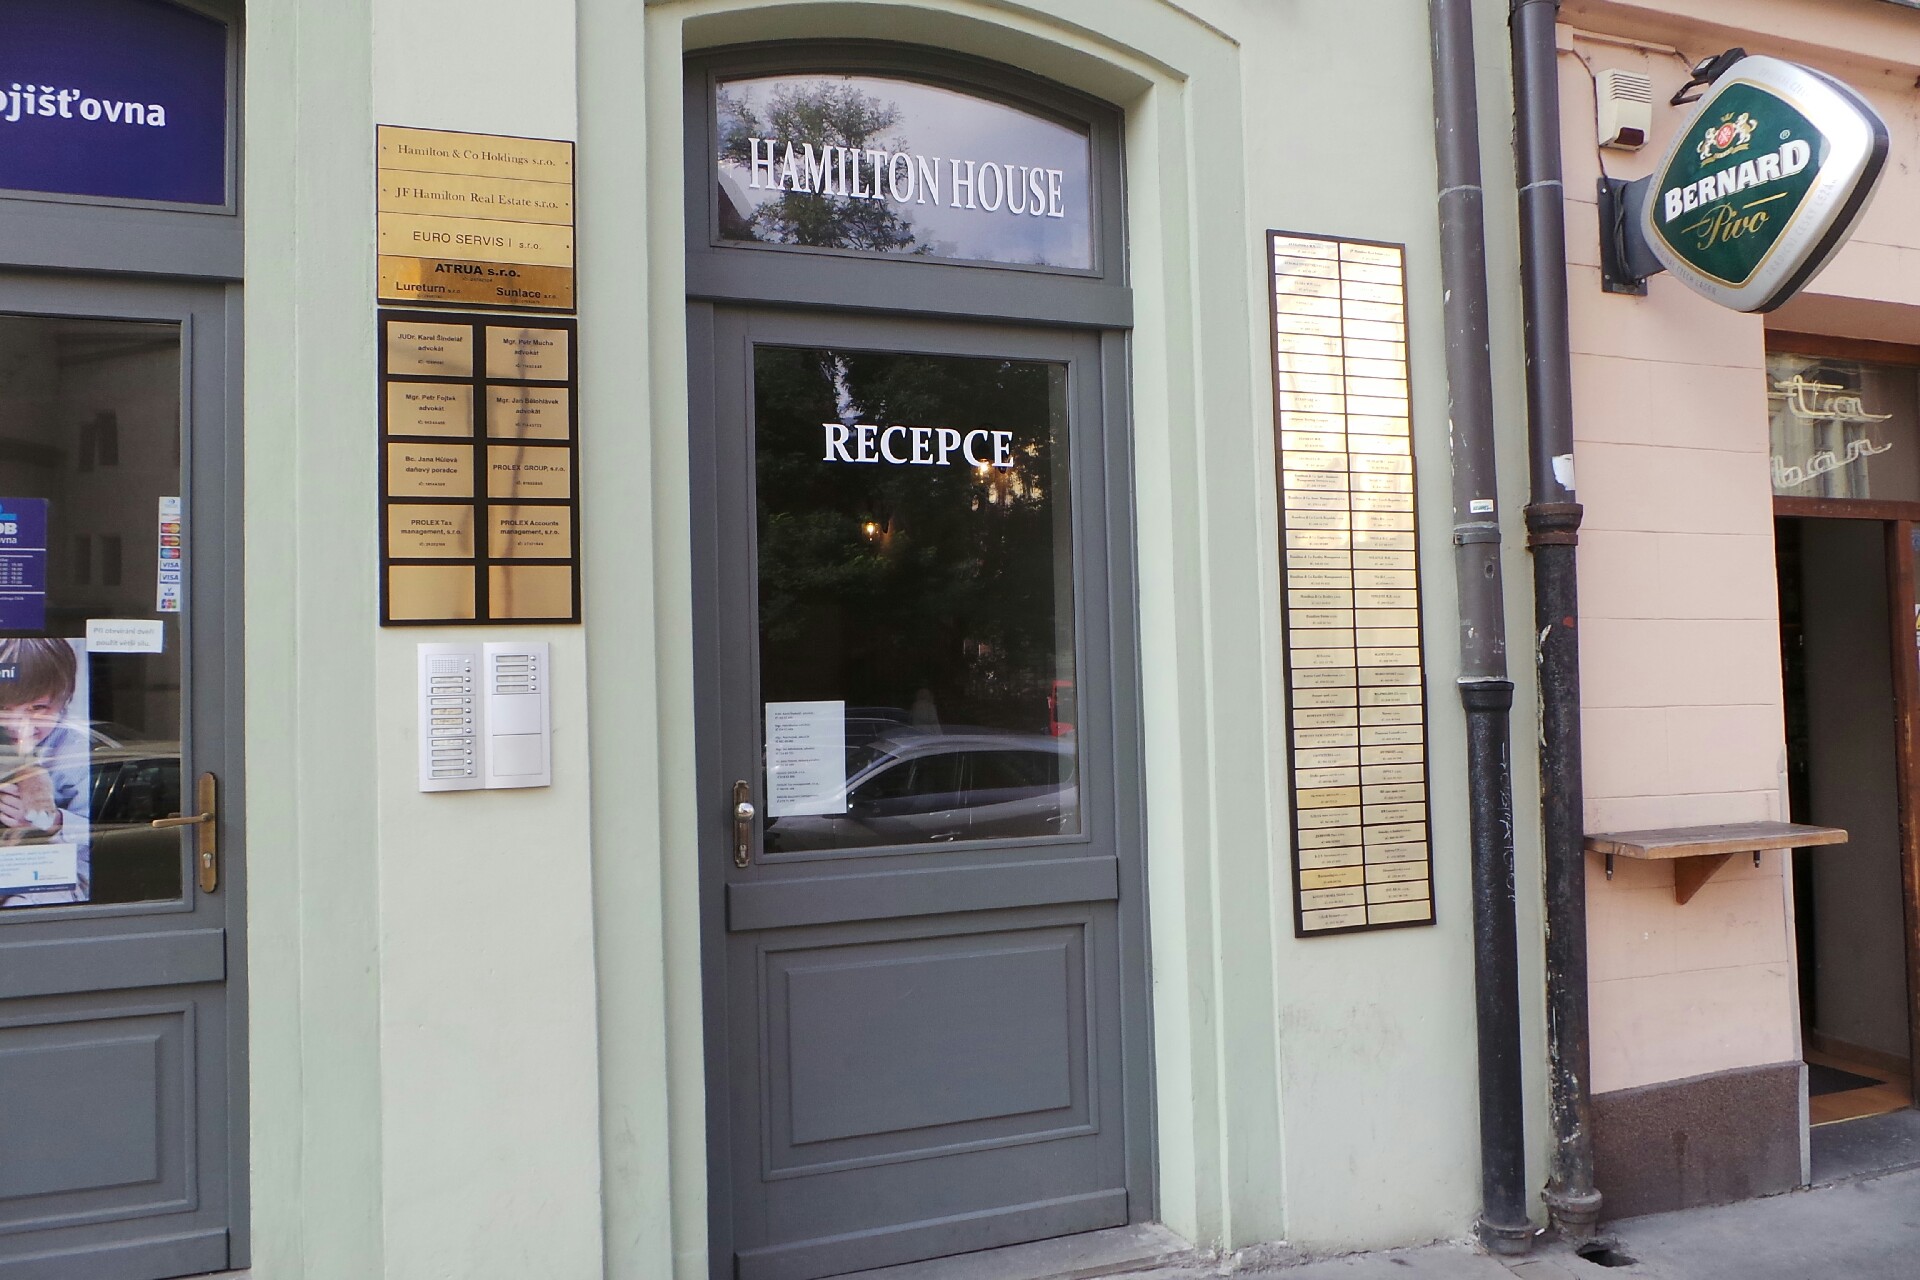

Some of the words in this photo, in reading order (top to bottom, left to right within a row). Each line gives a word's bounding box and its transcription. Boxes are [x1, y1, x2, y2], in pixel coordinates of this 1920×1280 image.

[398, 144, 449, 158] Hamilton
[452, 149, 461, 158] &
[463, 150, 479, 160] Co
[481, 151, 529, 165] Holdings
[532, 158, 556, 167] s.r.o.
[748, 137, 941, 206] HAMILTON
[950, 158, 1065, 218] HOUSE
[1664, 139, 1811, 224] BERNARD
[395, 187, 410, 198] JF
[413, 188, 465, 202] Hamilton
[470, 192, 494, 204] Real
[498, 195, 532, 207] Estate
[534, 200, 559, 210] s.r.o.
[1696, 201, 1770, 251] Pivo
[413, 231, 451, 243] EURO
[455, 234, 504, 247] SERVIS
[518, 242, 542, 250] s.r.o.
[435, 263, 483, 276] ATRUA
[487, 267, 521, 278] s.r.o.
[395, 282, 446, 294] Lureturn
[496, 287, 541, 299] Sunlace
[503, 338, 517, 346] Mgr.
[514, 348, 540, 356] advokát
[405, 393, 420, 401] Mgr.
[496, 397, 511, 405] Mgr.
[418, 404, 445, 412] advokát
[515, 407, 541, 415] advokát
[822, 423, 1015, 468] RECEPCE
[405, 455, 416, 463] Bc.
[405, 466, 431, 475] daňový
[431, 467, 458, 475] poradce
[400, 528, 446, 536] management,
[499, 528, 544, 536] management,
[0, 666, 15, 678] ní
